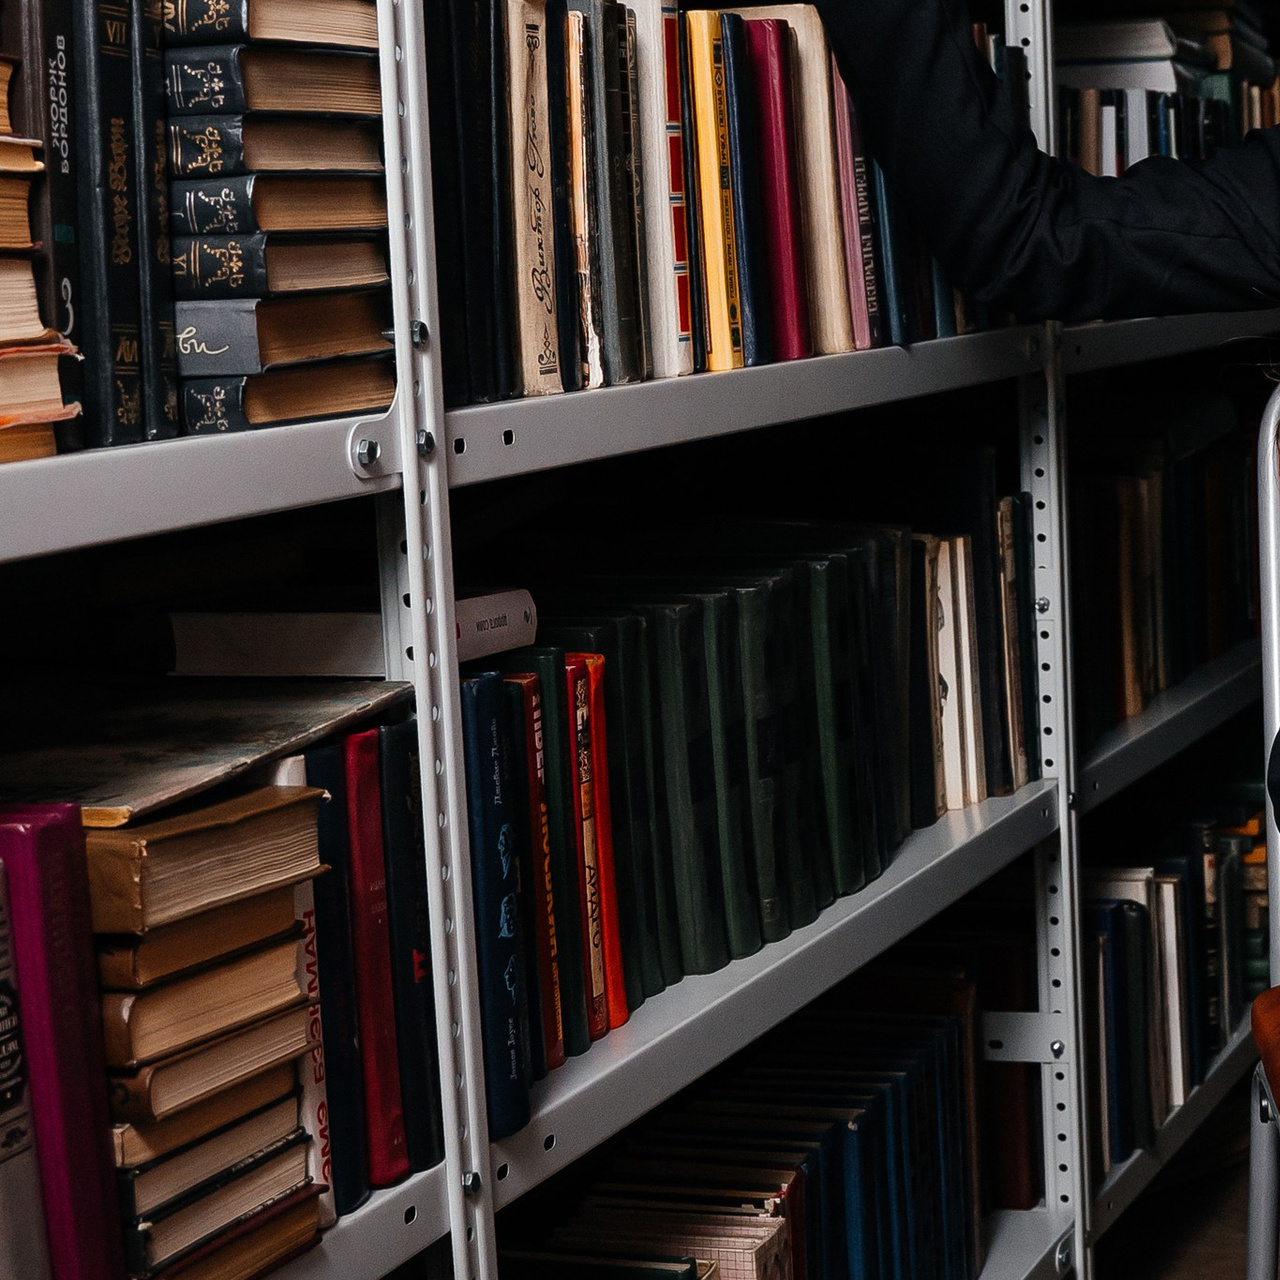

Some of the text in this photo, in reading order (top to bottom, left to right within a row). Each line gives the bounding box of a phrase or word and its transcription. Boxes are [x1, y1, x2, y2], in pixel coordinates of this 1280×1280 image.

[49, 57, 62, 148] ЖОРЖ
[55, 34, 71, 175] БОРДОНОВ
[524, 91, 553, 316] Виктор Гюго
[505, 1016, 518, 1081] James Joyce
